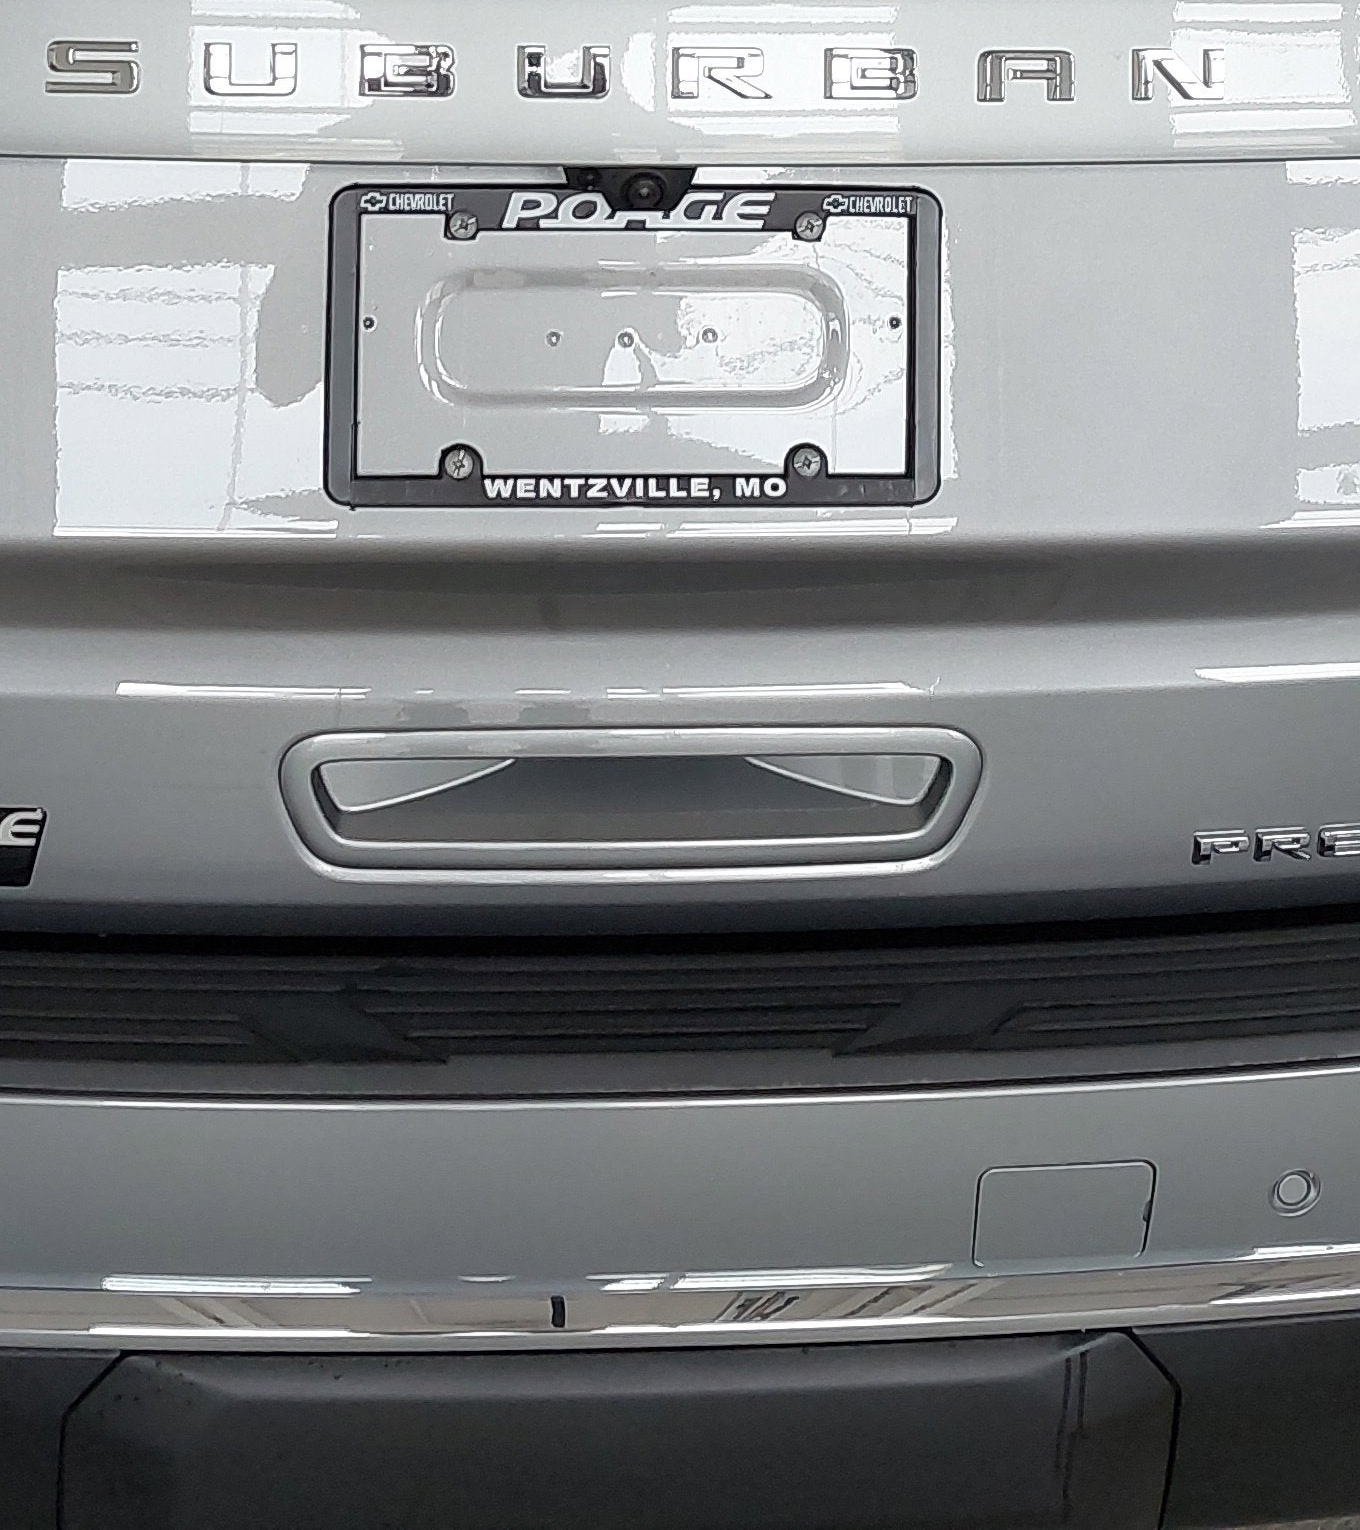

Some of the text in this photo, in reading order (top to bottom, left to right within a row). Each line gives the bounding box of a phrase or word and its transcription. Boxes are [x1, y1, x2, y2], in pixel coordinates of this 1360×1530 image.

[45, 38, 1226, 103] SUBURBAN
[388, 193, 455, 212] CHEVROLET
[849, 195, 914, 214] CHEVROLET
[483, 477, 788, 501] WENTZVILLE, MO
